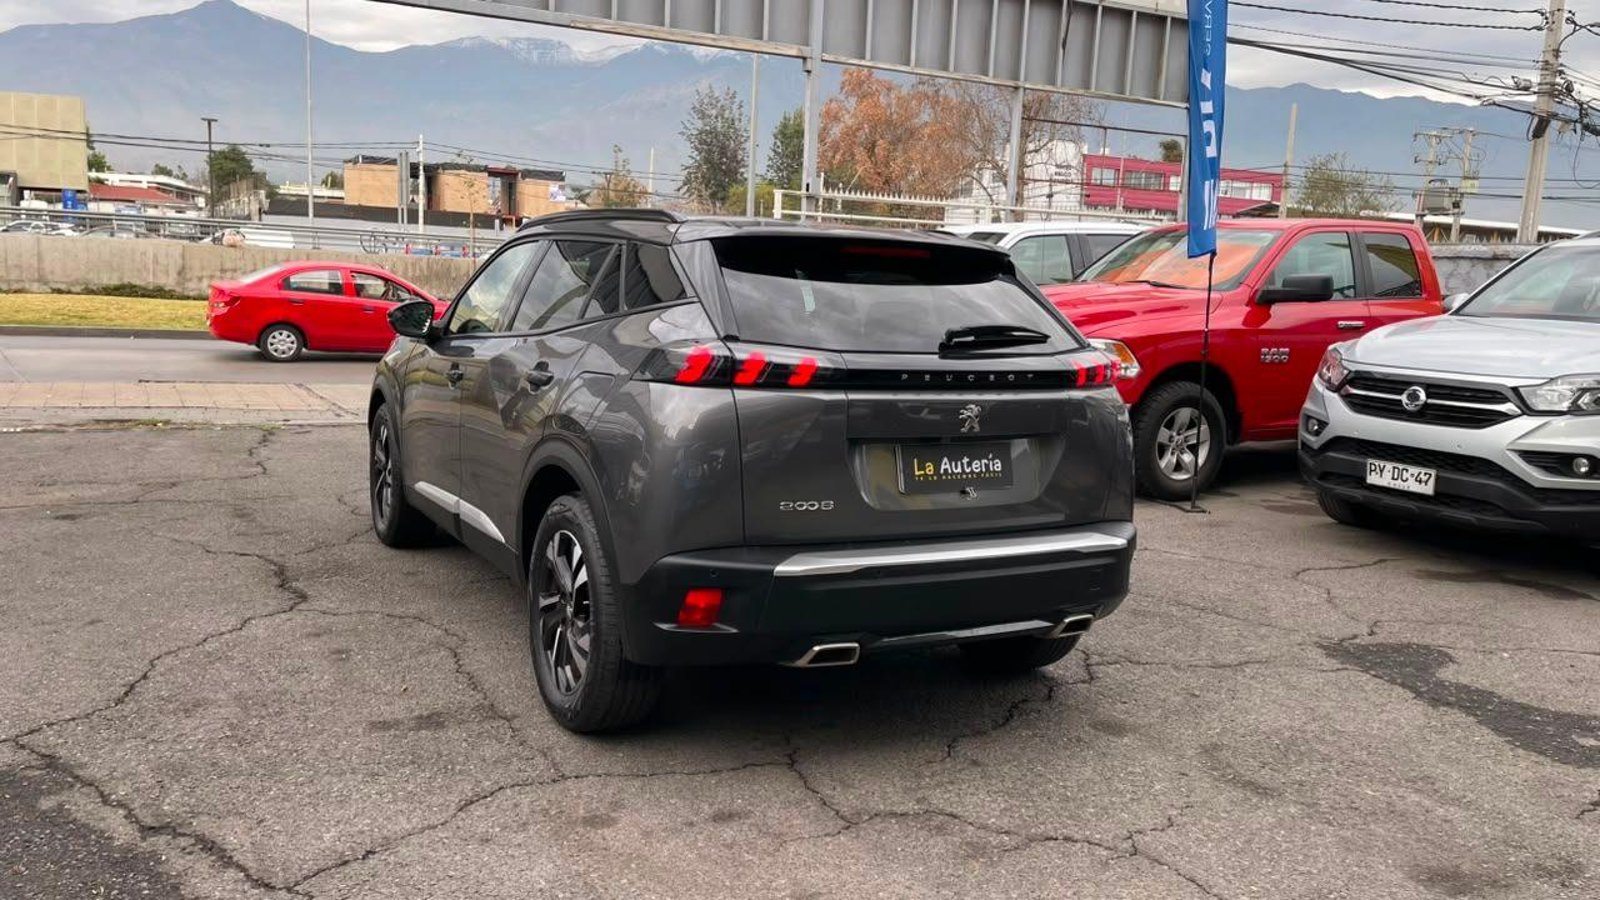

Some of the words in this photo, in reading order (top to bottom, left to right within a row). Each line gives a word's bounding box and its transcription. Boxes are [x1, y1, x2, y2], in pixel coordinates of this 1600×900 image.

[901, 373, 1034, 382] PEUGEOT
[914, 458, 934, 475] La
[940, 453, 1002, 474] Autería
[779, 500, 834, 511] 2008
